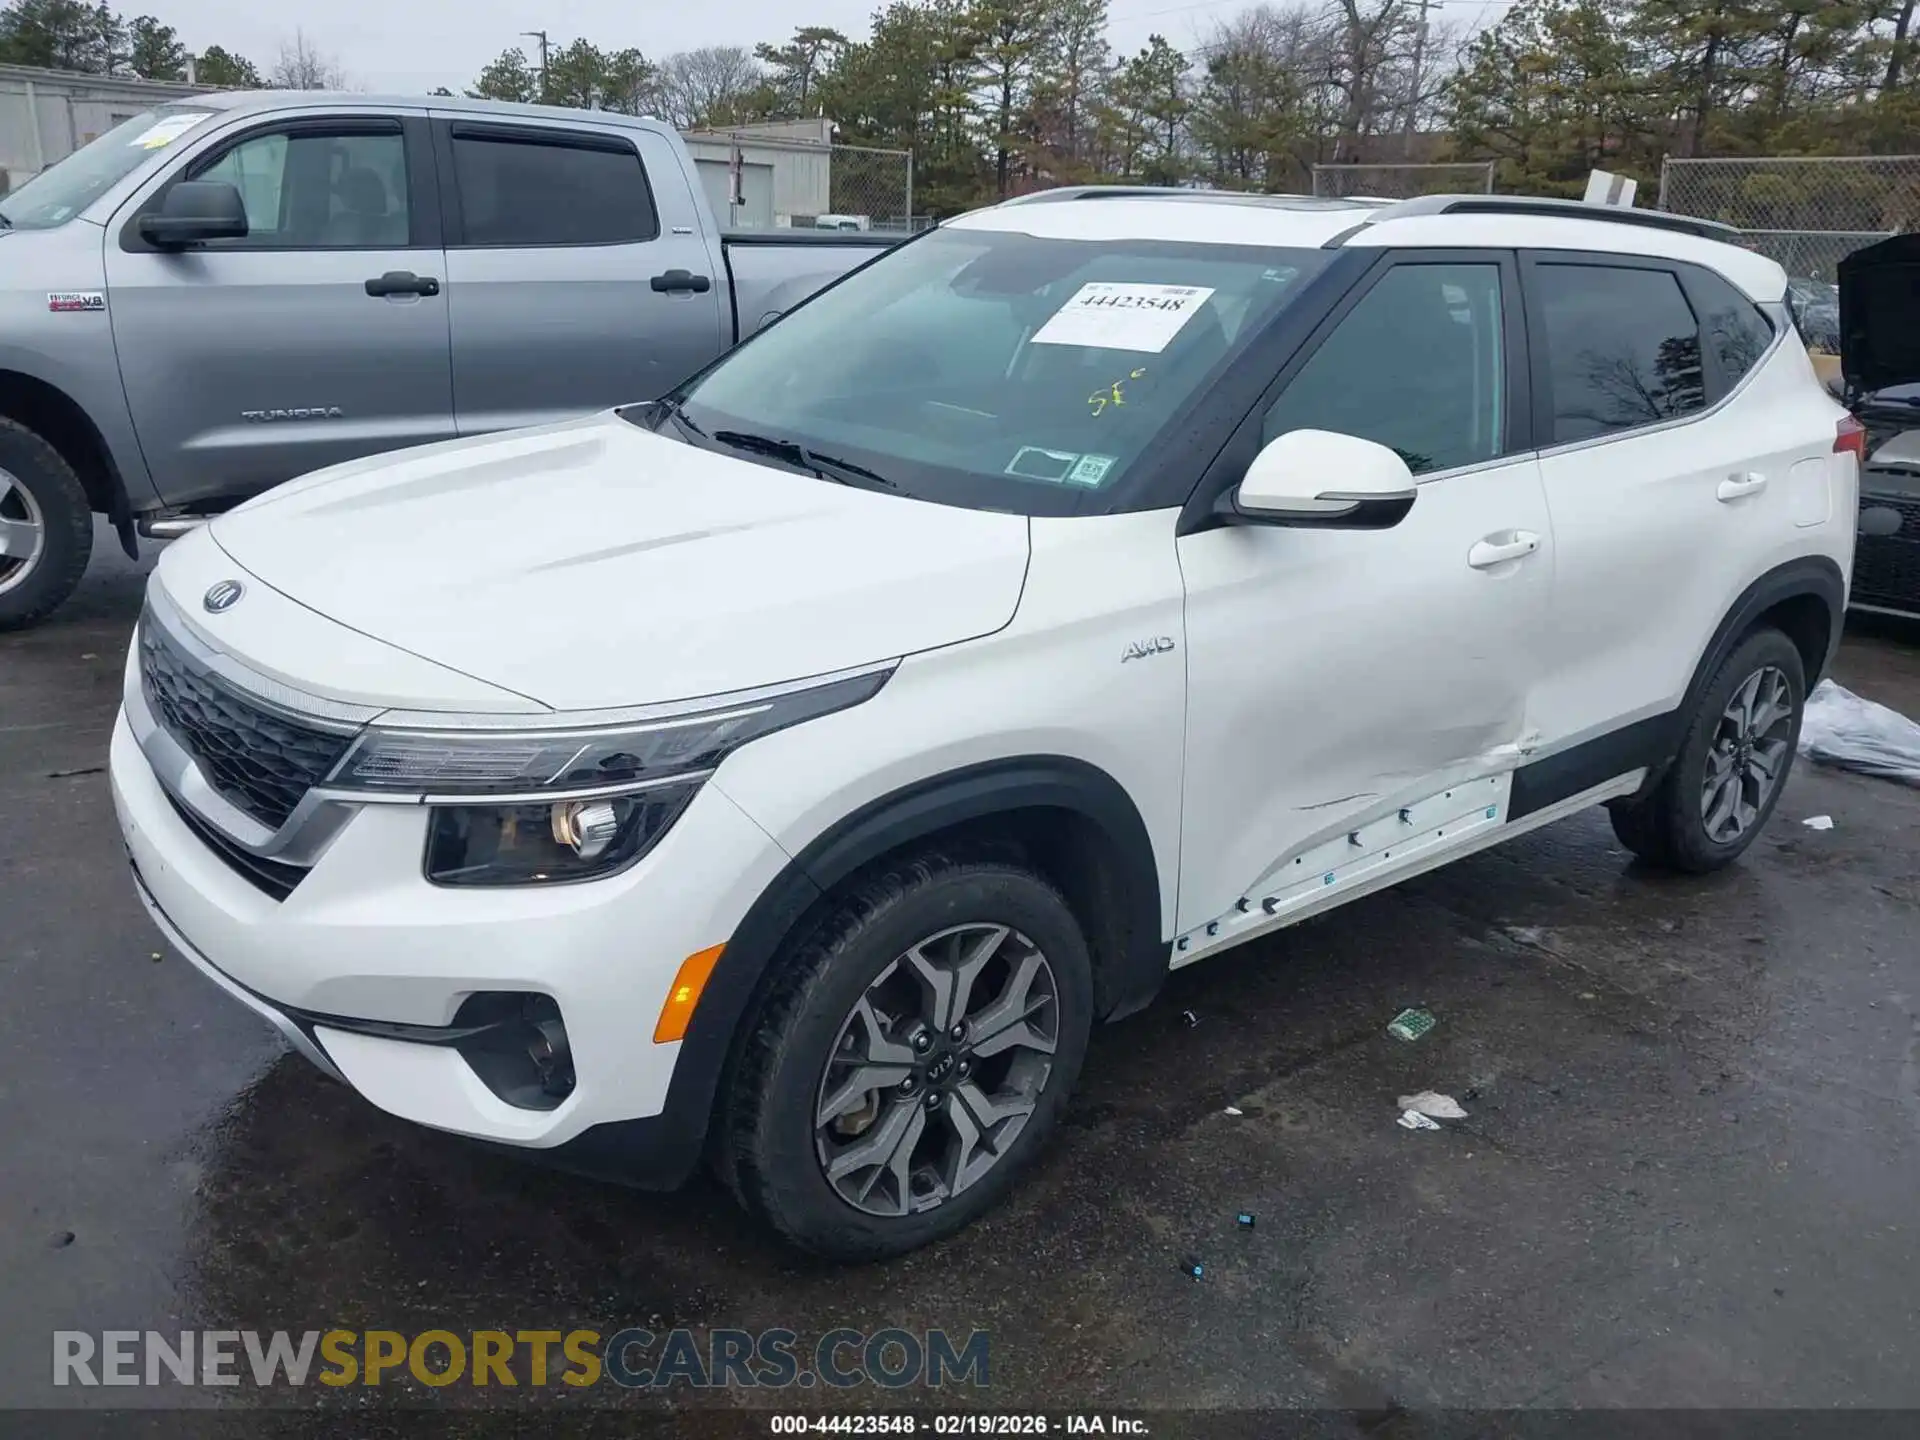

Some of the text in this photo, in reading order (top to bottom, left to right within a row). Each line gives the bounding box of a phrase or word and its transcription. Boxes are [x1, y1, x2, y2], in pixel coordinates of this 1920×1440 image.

[82, 295, 103, 306] V8
[1081, 295, 1185, 311] 44423548
[1120, 636, 1175, 664] AWD
